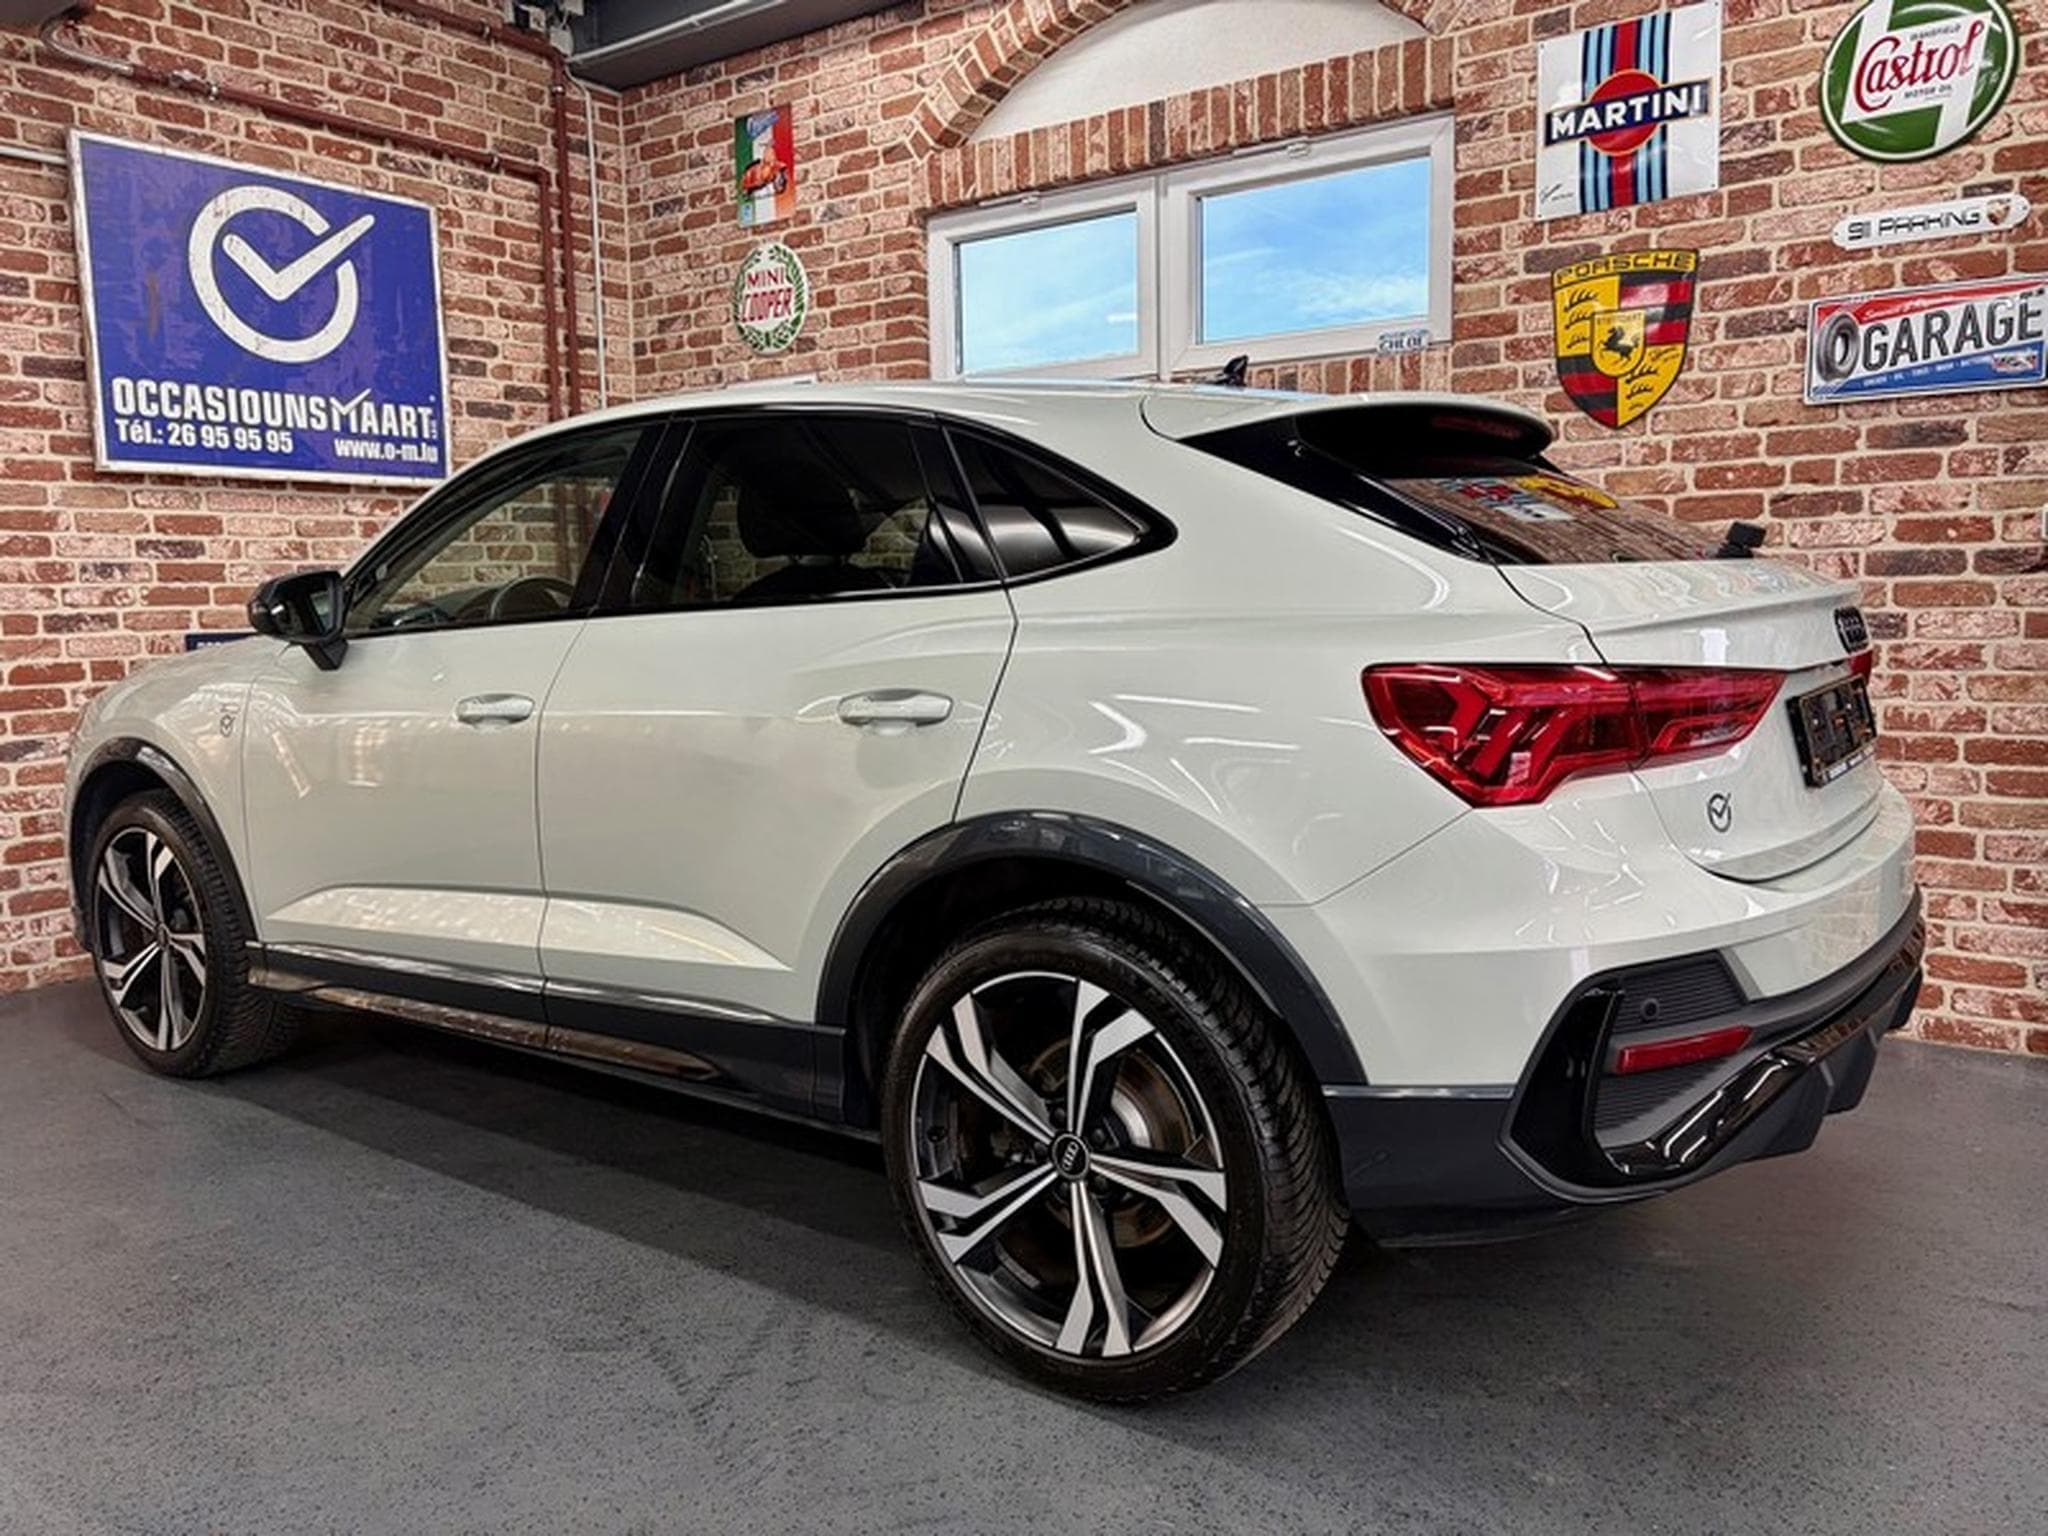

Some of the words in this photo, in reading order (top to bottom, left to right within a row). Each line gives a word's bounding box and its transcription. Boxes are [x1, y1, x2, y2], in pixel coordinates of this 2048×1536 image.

[1854, 19, 1985, 112] Castrol
[1552, 85, 1700, 140] MARTINI
[1878, 207, 1980, 236] PARKING
[747, 266, 785, 290] MINI
[1557, 251, 1692, 284] PORSCHE
[741, 287, 793, 323] COOPER
[1862, 288, 2045, 372] GARAGE
[111, 376, 433, 439] OCCASIOUNSMAART
[115, 418, 163, 444] Tél.:
[167, 422, 197, 447] 26
[200, 424, 230, 449] 95
[233, 426, 263, 451] 95
[265, 428, 294, 454] 95
[333, 437, 439, 463] www.o-m.lu
